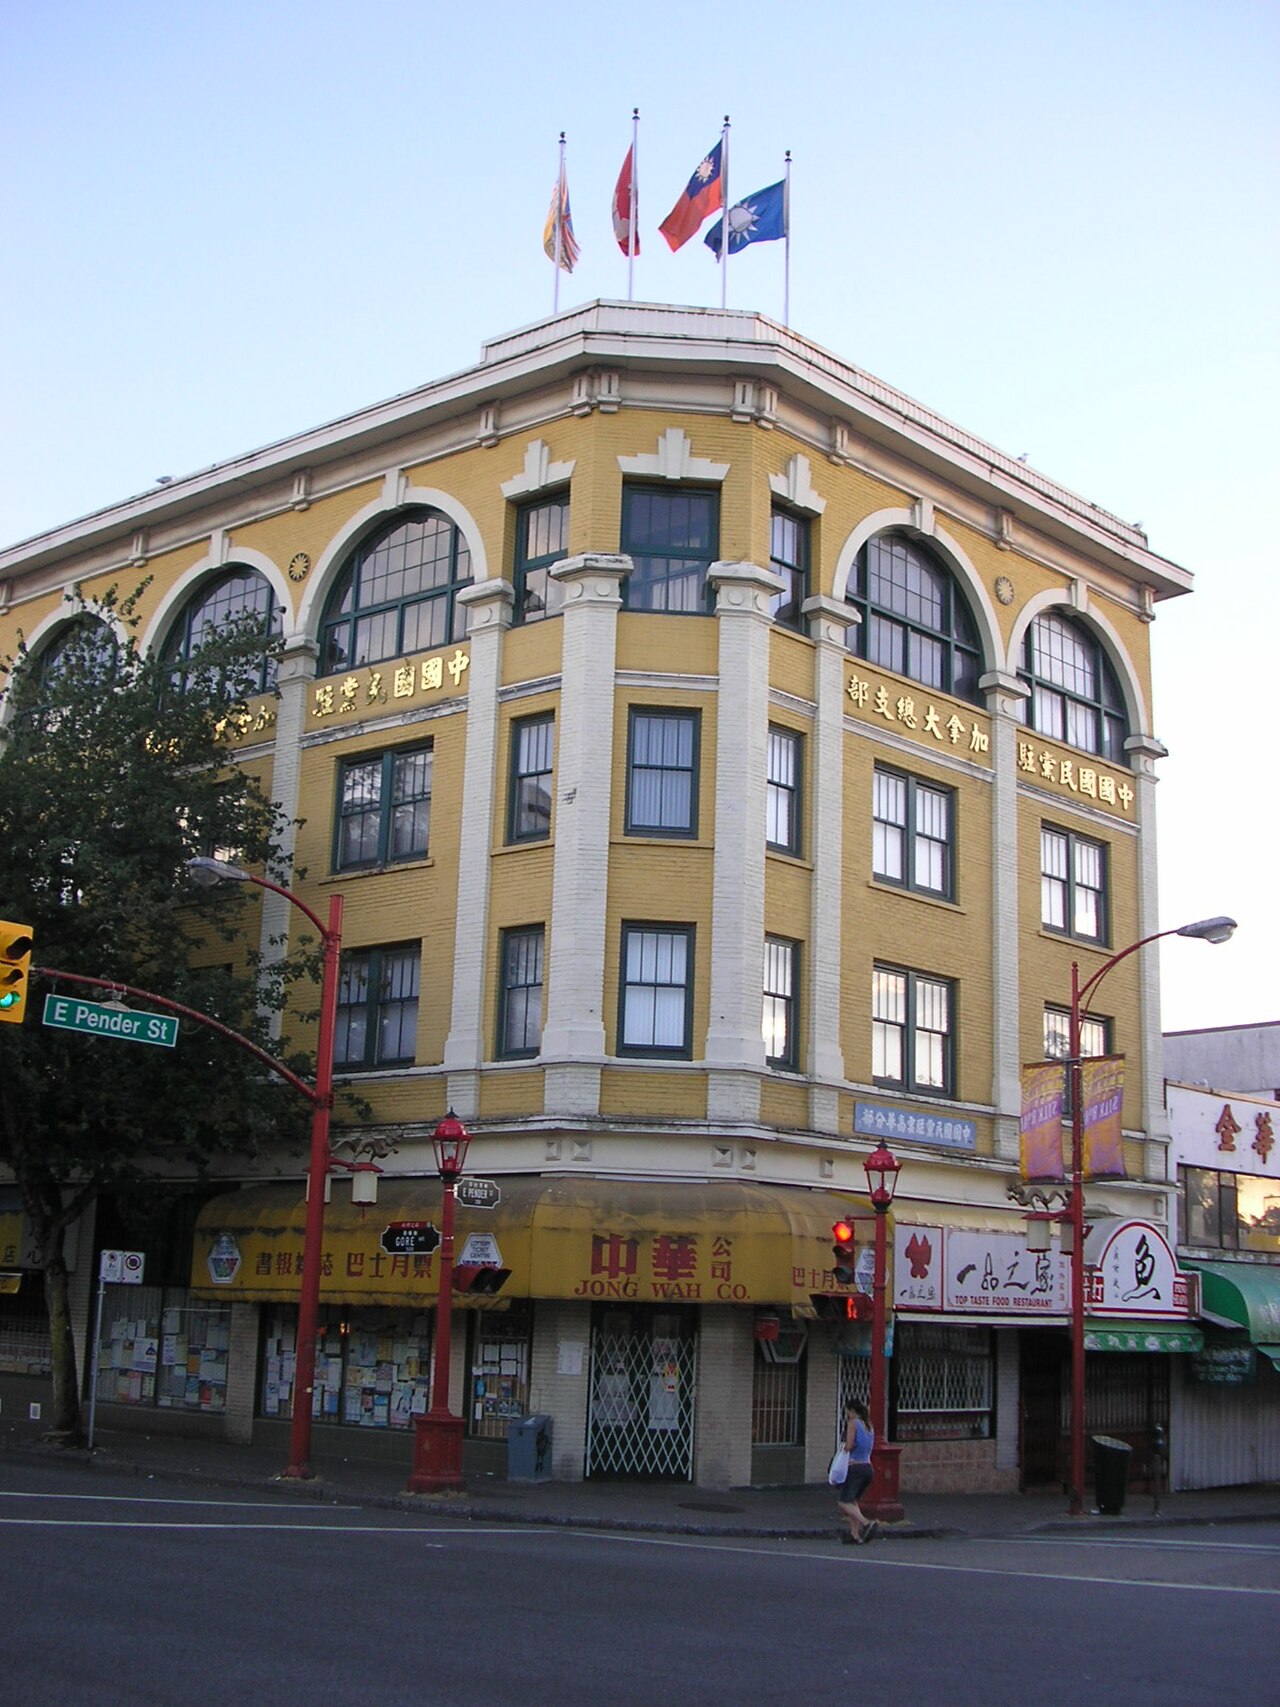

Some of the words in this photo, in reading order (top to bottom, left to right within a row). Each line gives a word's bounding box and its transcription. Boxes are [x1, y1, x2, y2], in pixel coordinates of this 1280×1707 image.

[54, 1001, 69, 1022] E
[75, 1006, 141, 1035] Pender
[147, 1019, 168, 1040] St
[395, 1236, 415, 1247] GORE
[575, 1279, 639, 1298] JONG
[650, 1283, 702, 1298] WAH
[717, 1284, 751, 1300] CO.
[955, 1295, 967, 1305] TOP
[970, 1296, 990, 1306] TASTE
[992, 1297, 1010, 1307] FOOD
[1013, 1298, 1053, 1308] RESTAURANT
